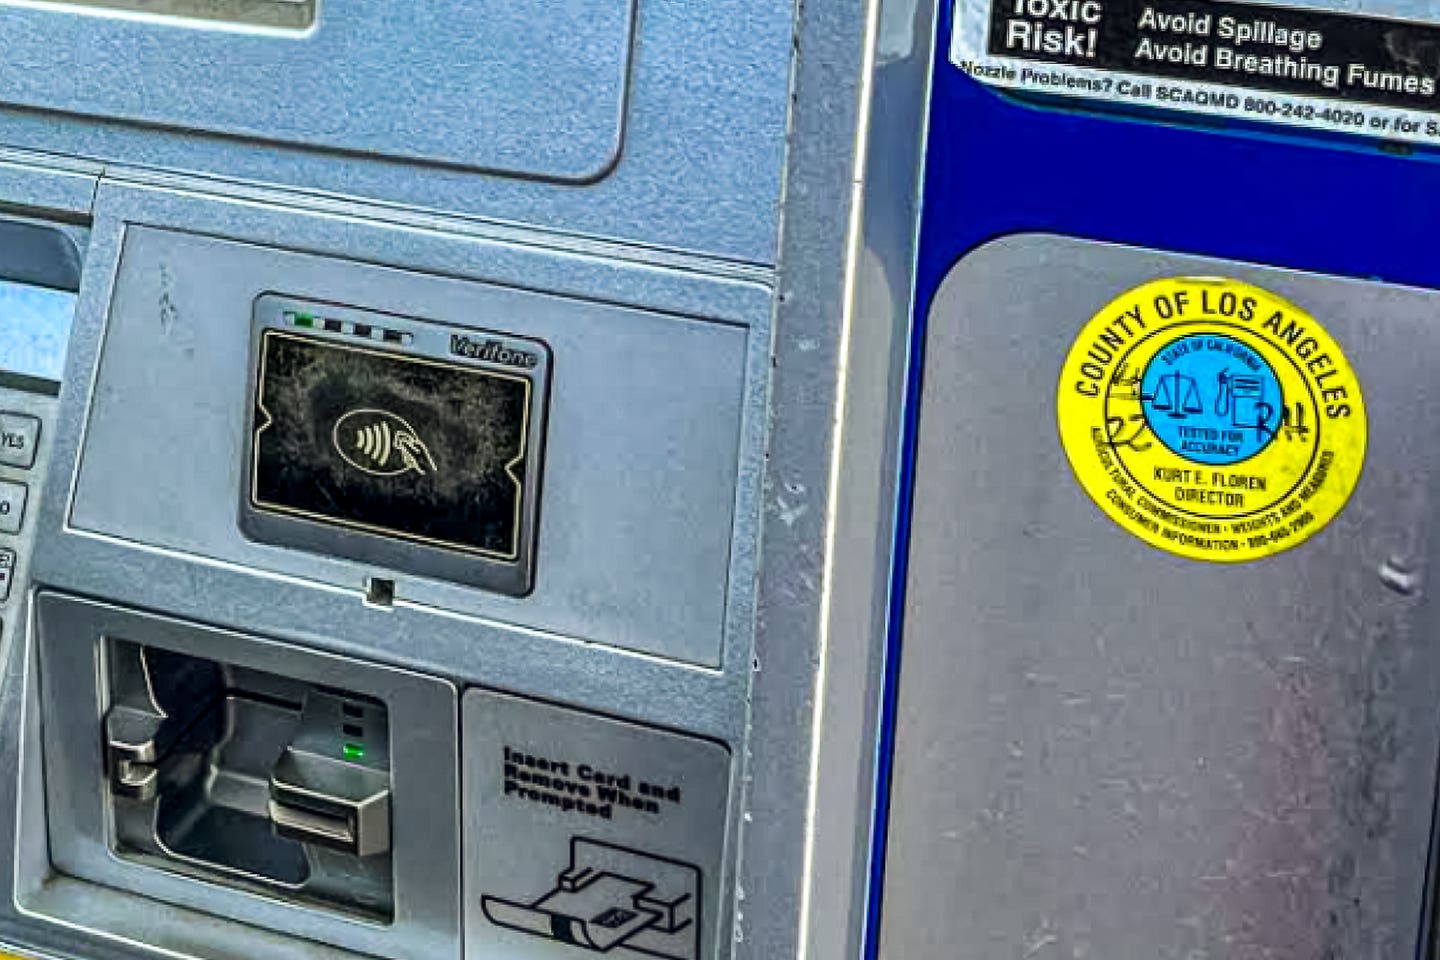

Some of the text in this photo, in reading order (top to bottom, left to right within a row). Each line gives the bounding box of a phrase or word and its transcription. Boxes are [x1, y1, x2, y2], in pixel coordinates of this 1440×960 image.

[1006, 18, 1098, 58] Risk!
[1138, 8, 1323, 52] Avoid Spillage
[1021, 68, 1112, 92] Problems?
[1116, 79, 1152, 98] Call
[1134, 38, 1436, 95] Avoid Breathing Fumes
[450, 334, 538, 368] Verifone
[1076, 304, 1147, 397] COUNTY
[1154, 290, 1190, 319] OF
[1201, 289, 1258, 321] LOS
[1261, 310, 1351, 420] ANGELES
[504, 745, 681, 804] Insert Card and
[504, 763, 660, 814] Remove When
[504, 779, 613, 820] Prompted
